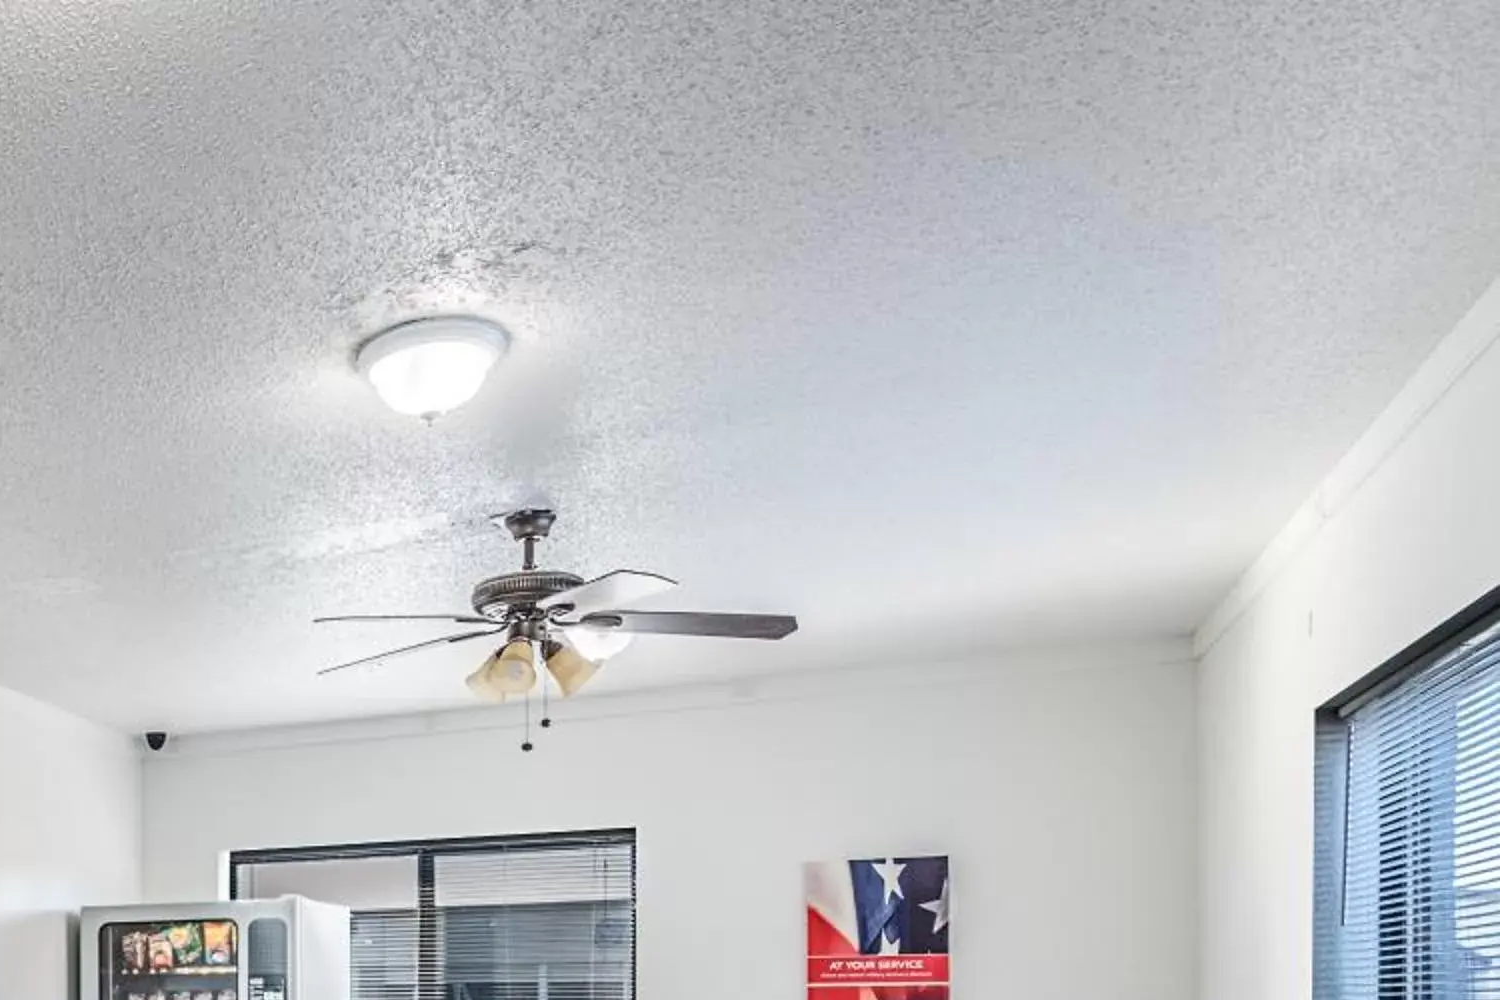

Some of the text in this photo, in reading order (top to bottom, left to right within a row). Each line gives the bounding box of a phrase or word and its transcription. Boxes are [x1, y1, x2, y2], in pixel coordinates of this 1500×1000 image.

[829, 960, 924, 970] AT YOUR SERVICE
